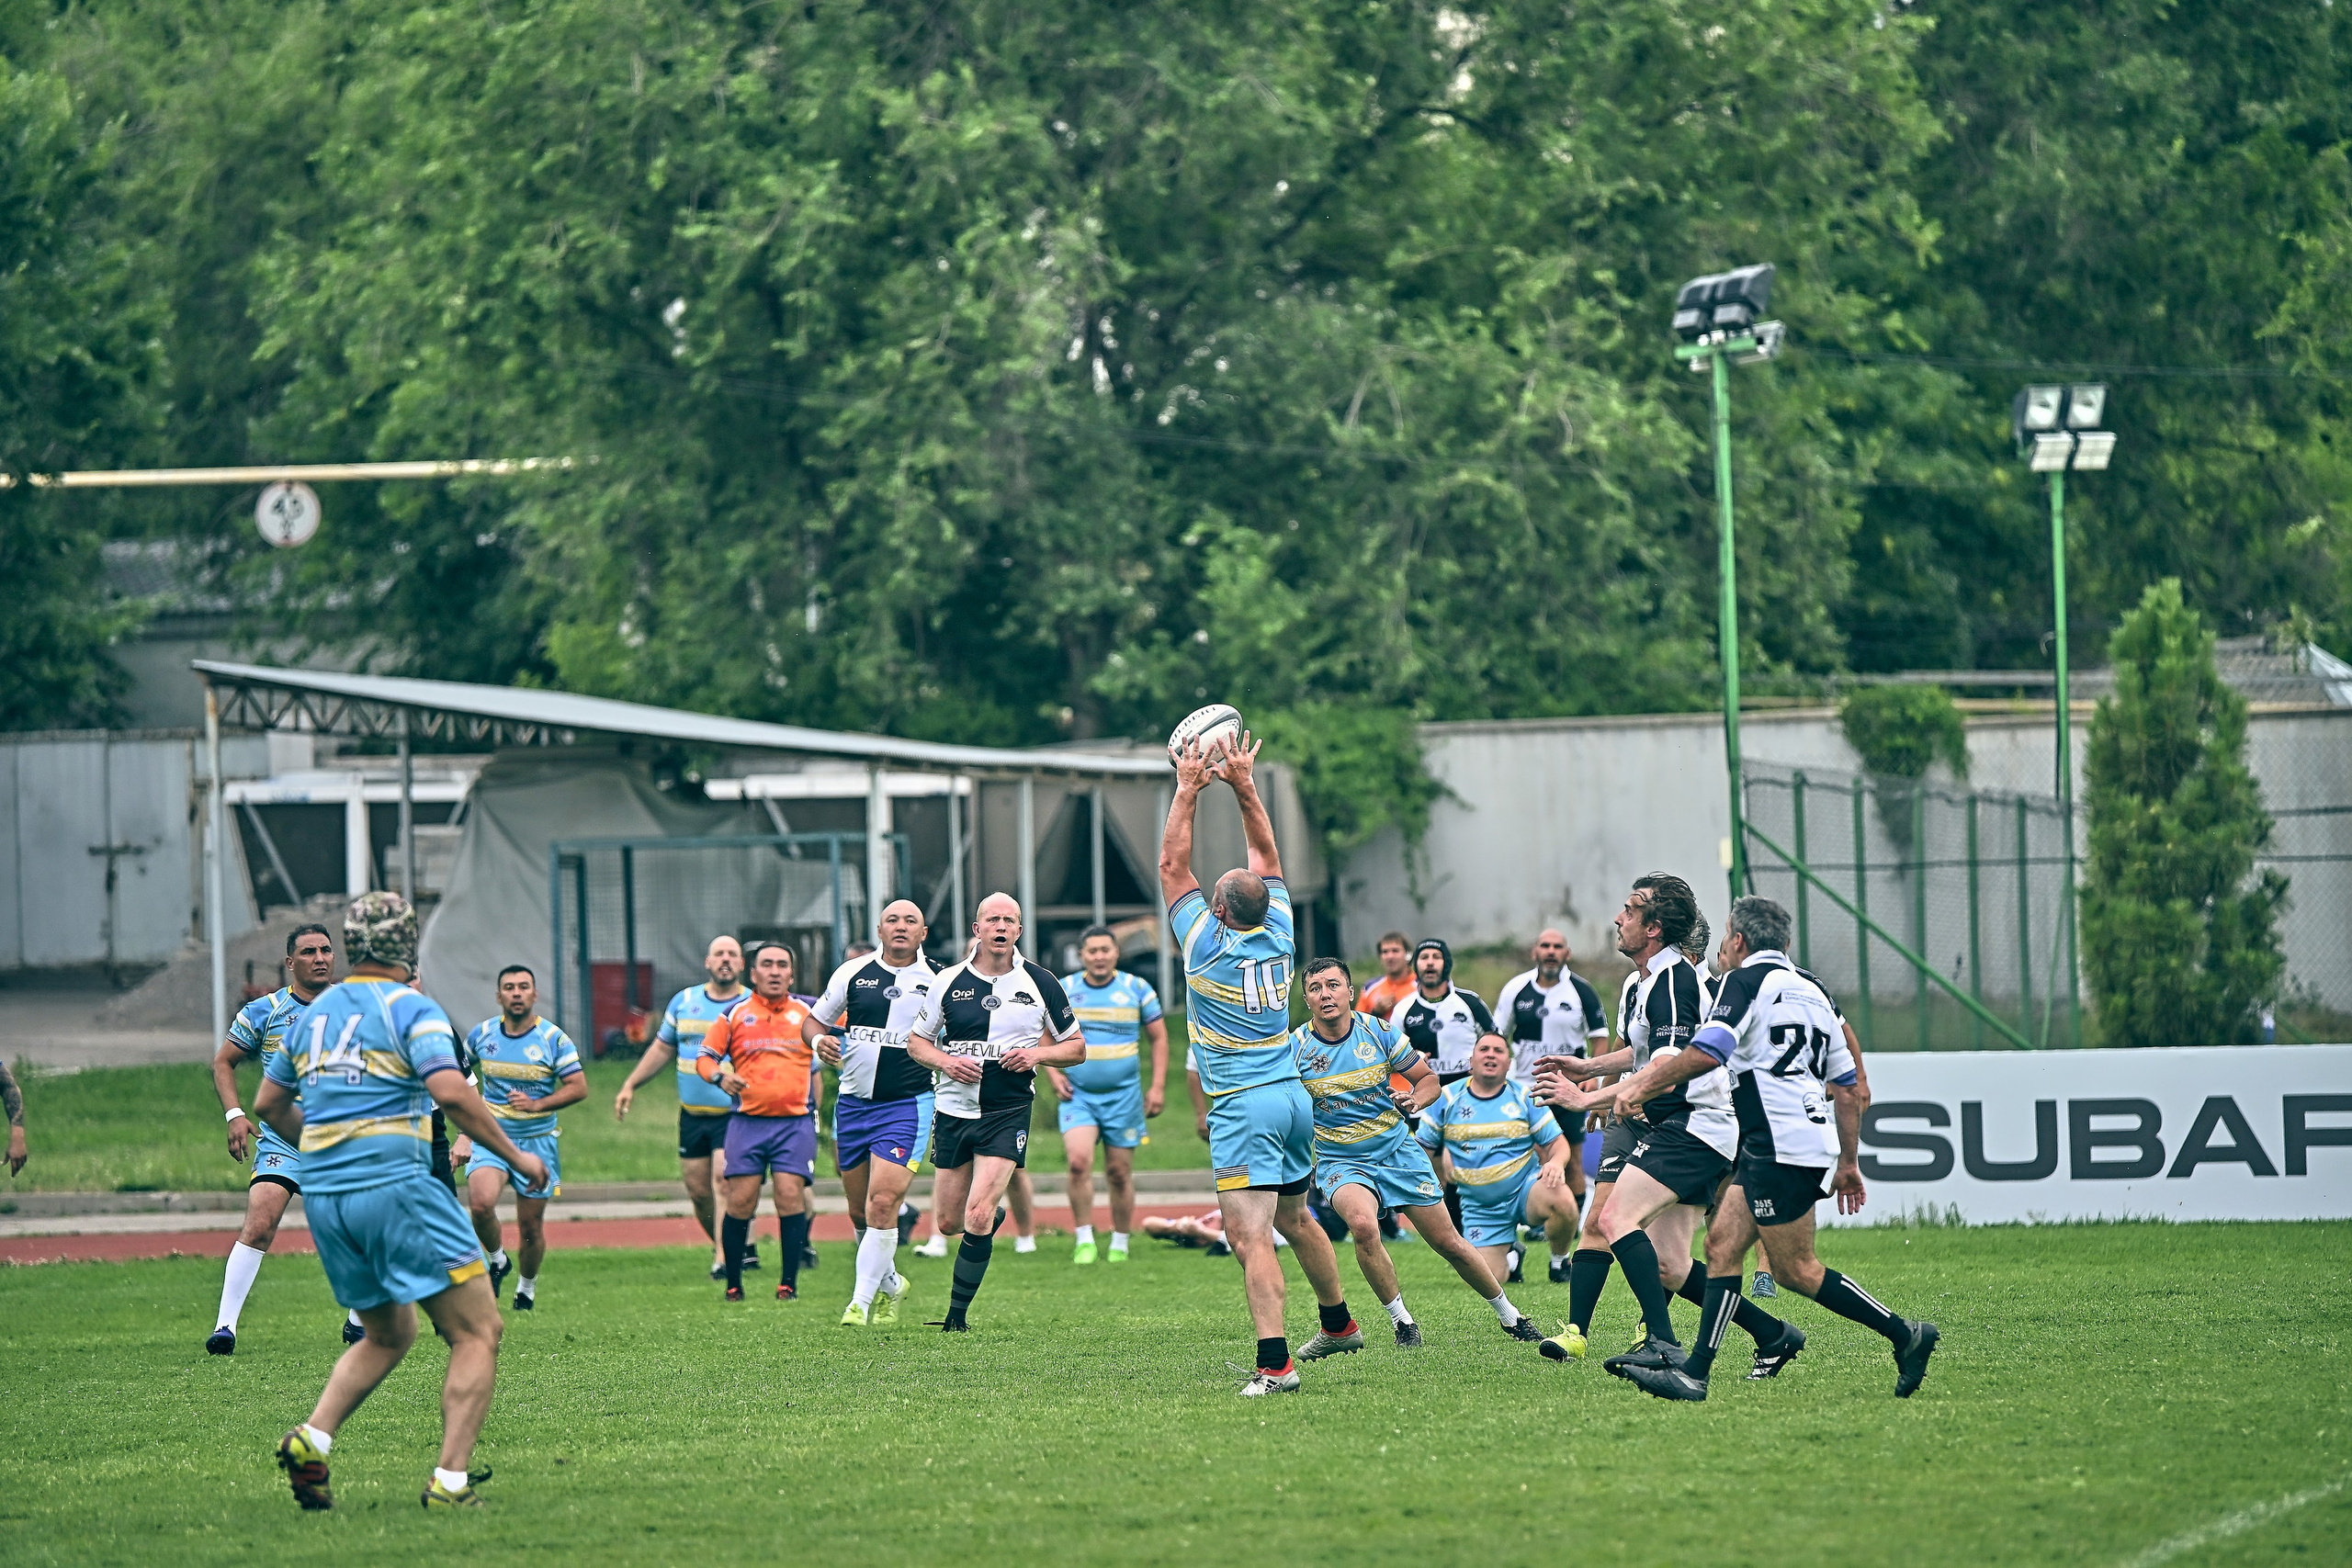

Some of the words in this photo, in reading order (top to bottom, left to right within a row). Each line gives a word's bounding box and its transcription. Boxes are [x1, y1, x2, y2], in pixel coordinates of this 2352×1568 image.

[855, 978, 879, 987] Orpi
[1235, 953, 1291, 1013] 10
[952, 987, 975, 998] Orpi
[307, 1013, 366, 1086] 14
[959, 1042, 1027, 1058] CHEVILL
[1768, 1021, 1831, 1082] 20
[1754, 1199, 1774, 1208] 3615
